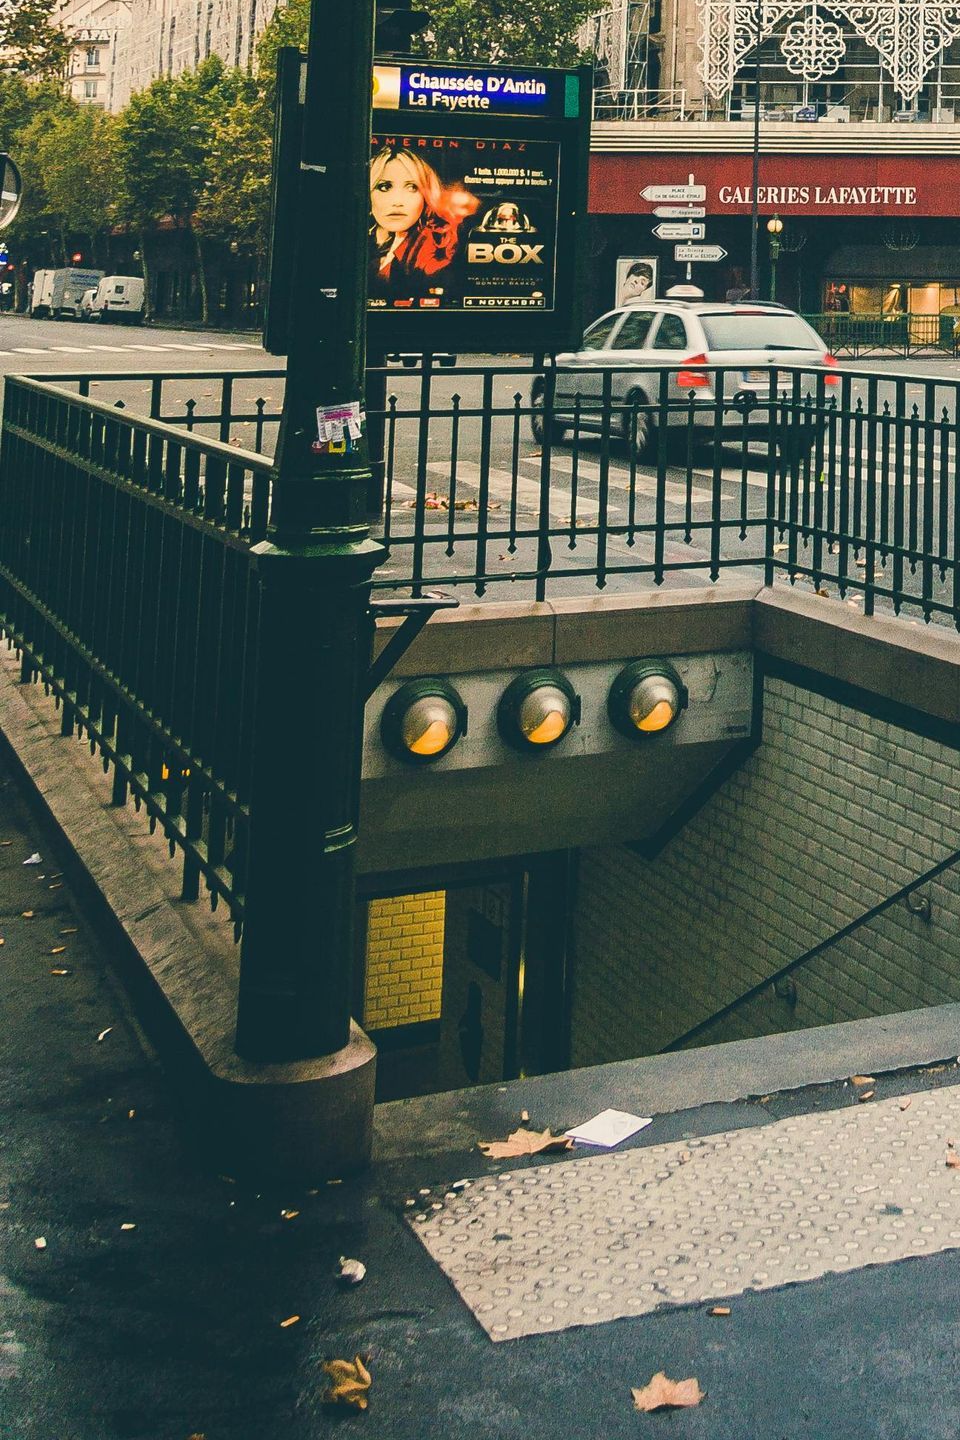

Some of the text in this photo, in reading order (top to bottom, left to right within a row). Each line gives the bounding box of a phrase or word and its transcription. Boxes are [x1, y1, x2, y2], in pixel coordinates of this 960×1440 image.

[409, 72, 546, 94] Chaussée D'Antin
[408, 91, 490, 111] La Fayette
[370, 137, 526, 152] AMERON DIAZ
[718, 186, 917, 205] GALERIES LAFAYETTE
[468, 243, 545, 265] BOX
